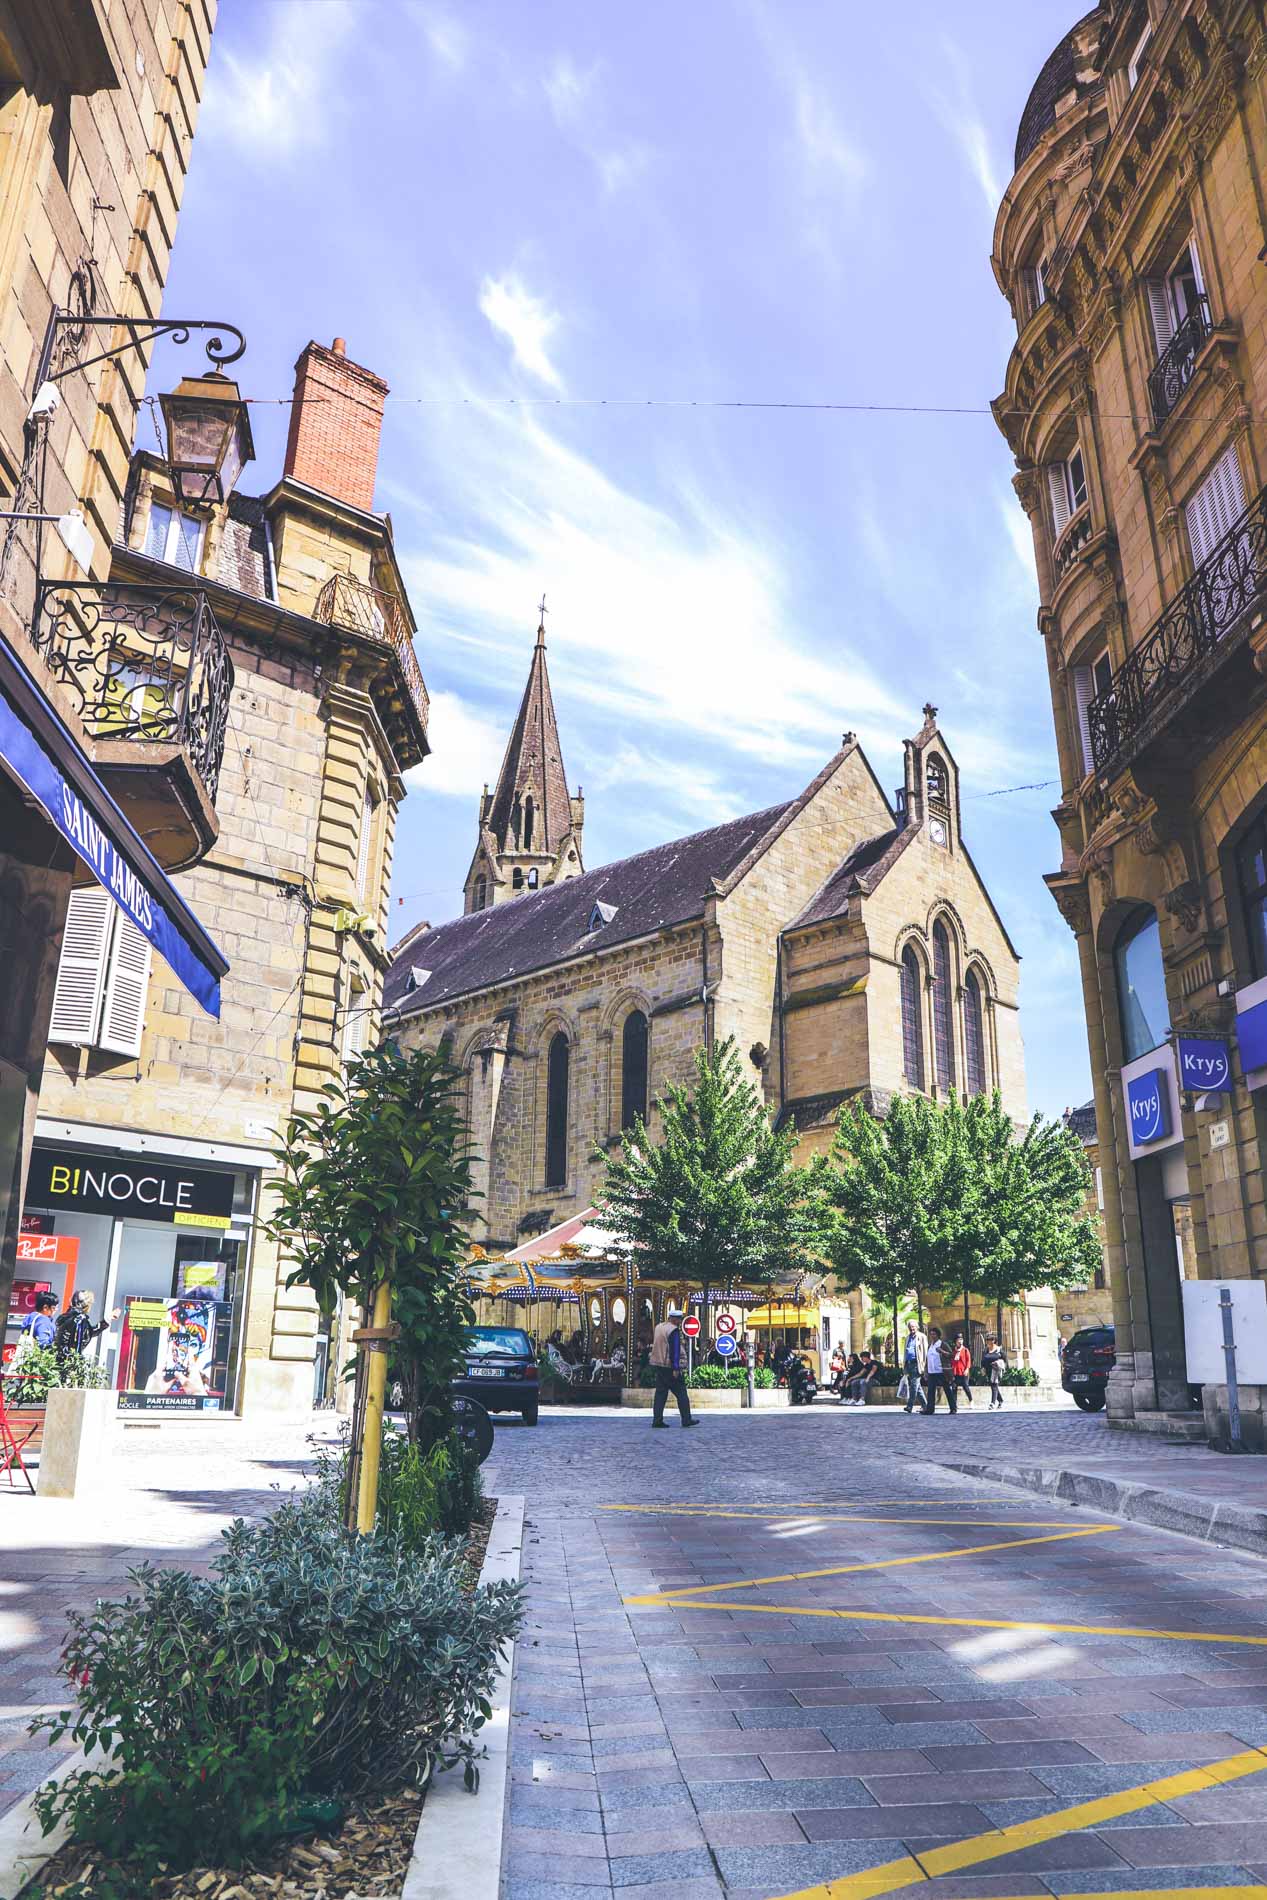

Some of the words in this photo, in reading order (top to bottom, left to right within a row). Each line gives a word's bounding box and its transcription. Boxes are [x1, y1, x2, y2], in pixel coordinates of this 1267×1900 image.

[63, 782, 110, 875] SAINT
[110, 847, 153, 931] JAMES
[1184, 1054, 1224, 1076] Krys
[1131, 1094, 1157, 1121] Krys
[178, 1214, 229, 1227] OPTICIENS
[146, 1397, 197, 1406] PARTENAIRES
